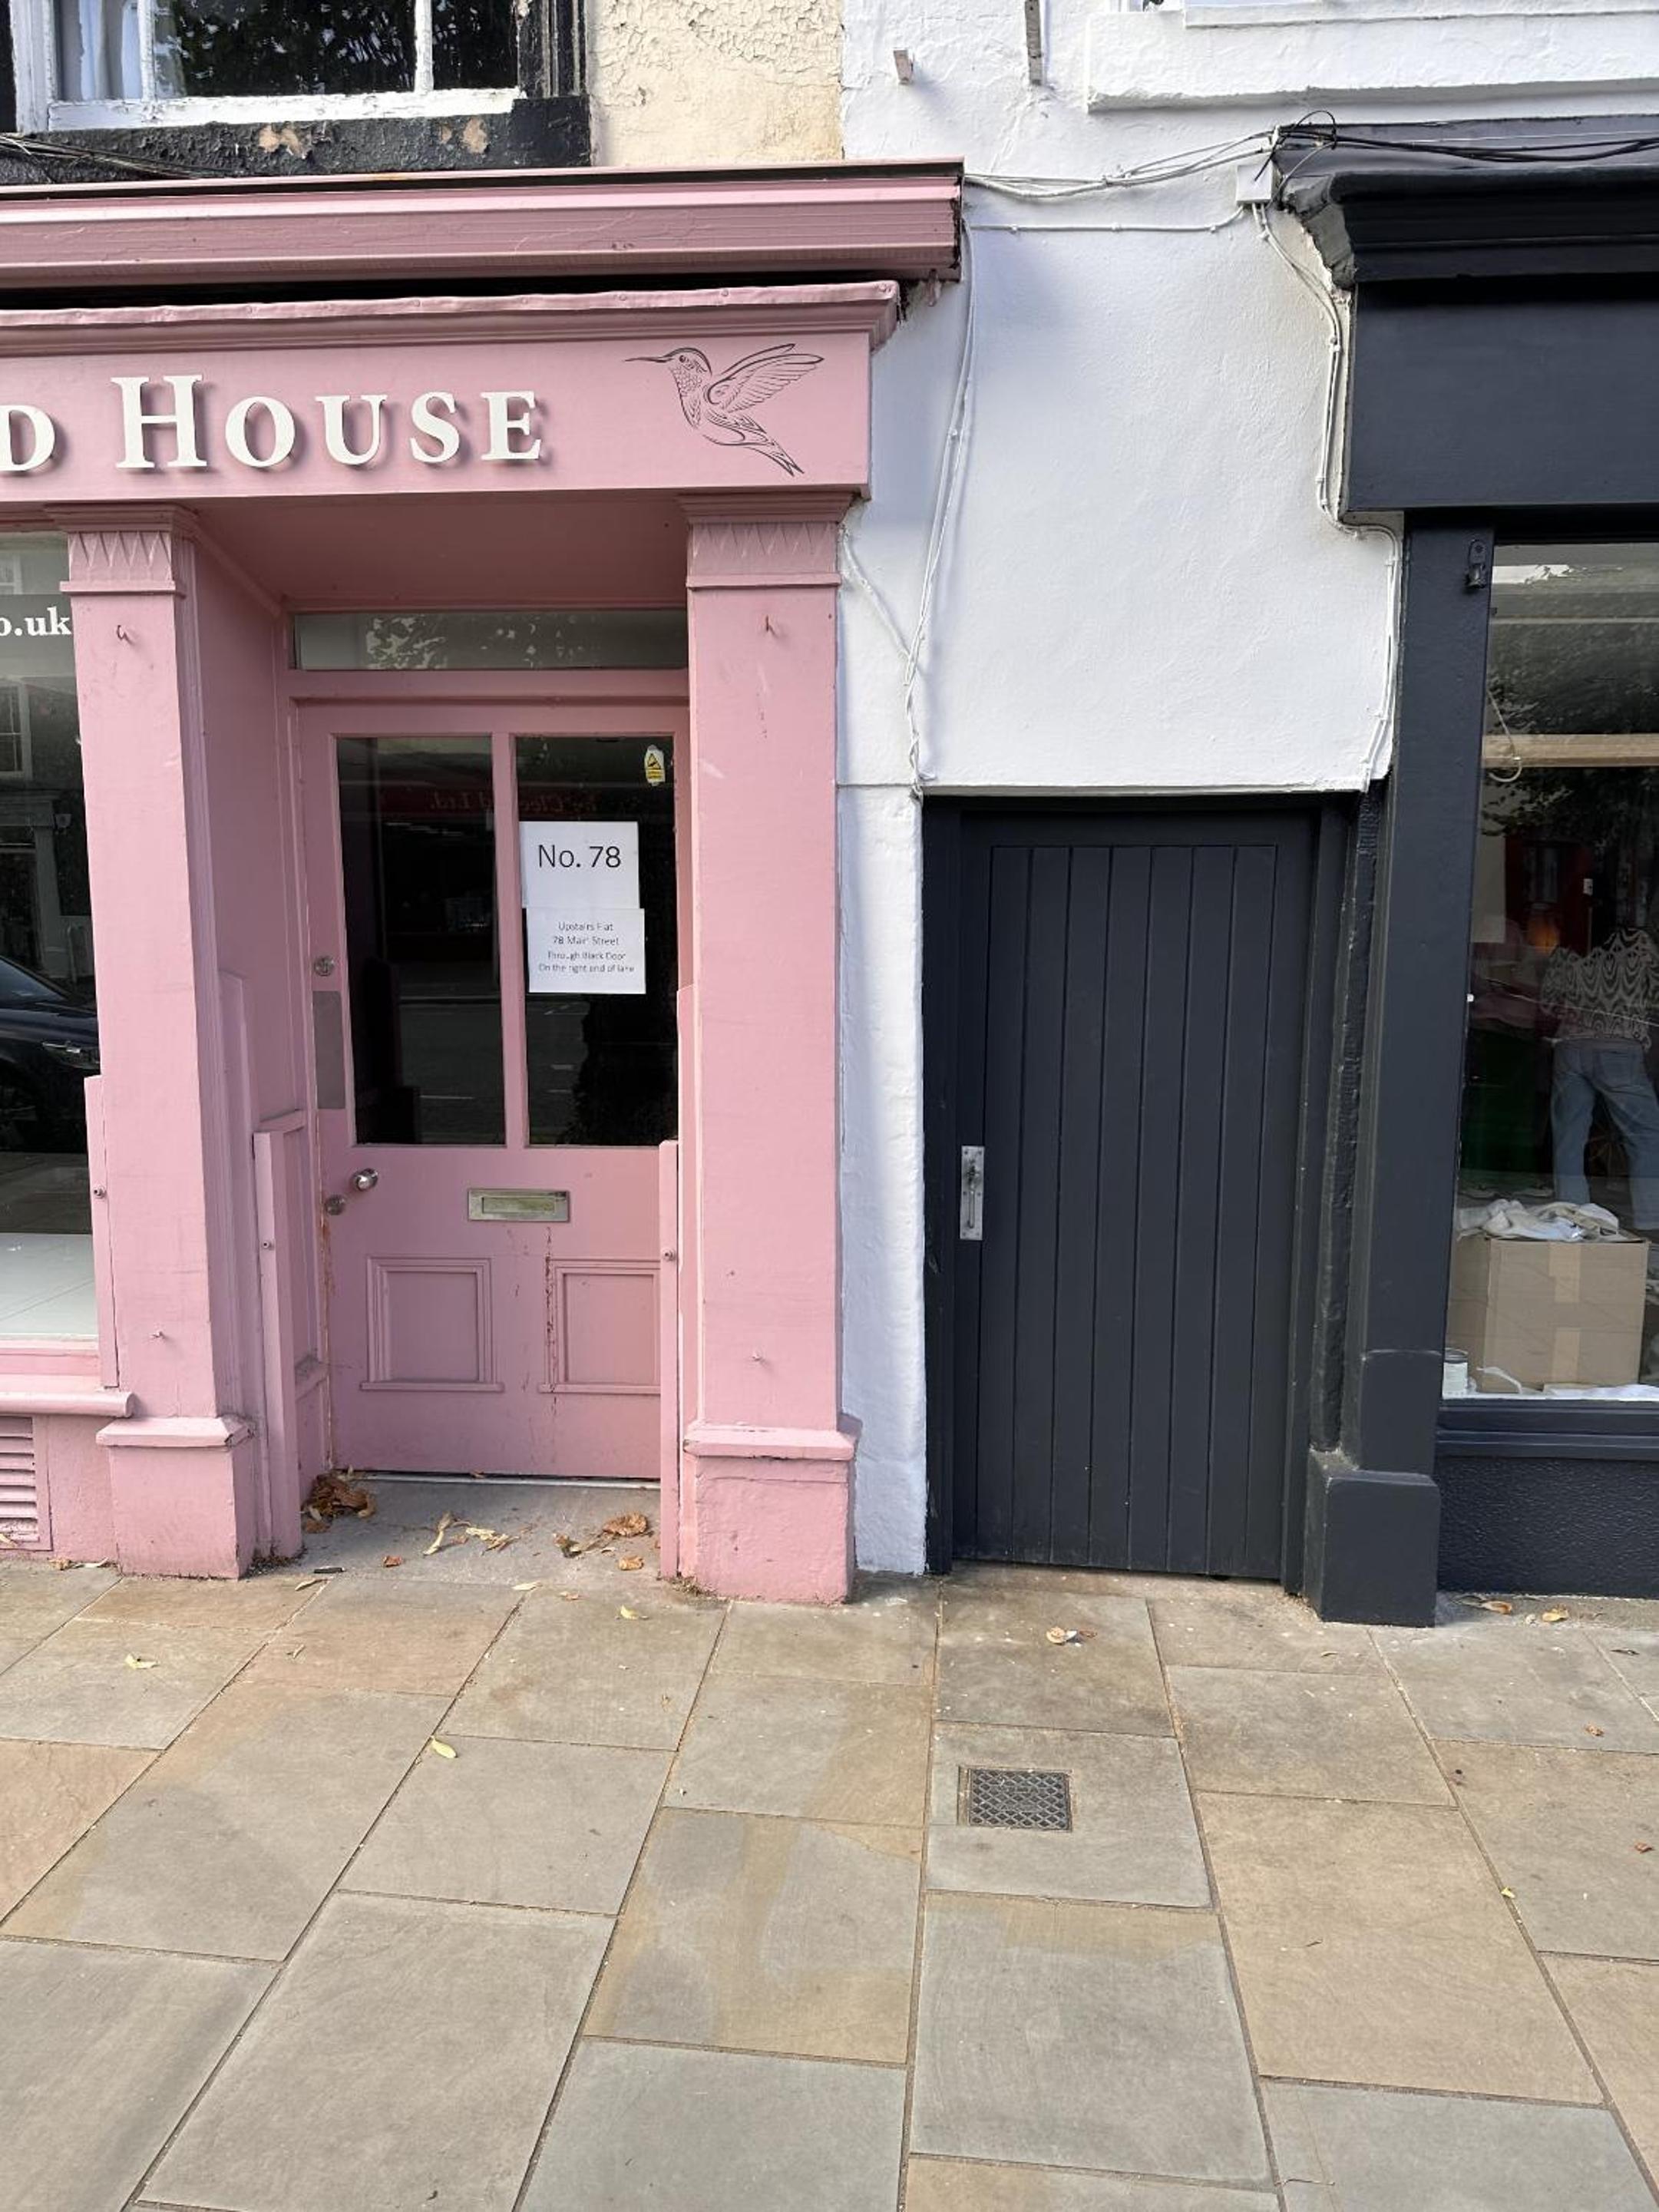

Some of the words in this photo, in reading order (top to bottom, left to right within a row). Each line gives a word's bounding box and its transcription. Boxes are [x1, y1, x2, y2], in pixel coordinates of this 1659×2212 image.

[111, 374, 543, 470] HOUSE
[538, 844, 581, 868] No.
[589, 845, 622, 868] 78
[597, 922, 614, 931] Fat
[554, 936, 564, 944] 78
[592, 936, 620, 945] Street
